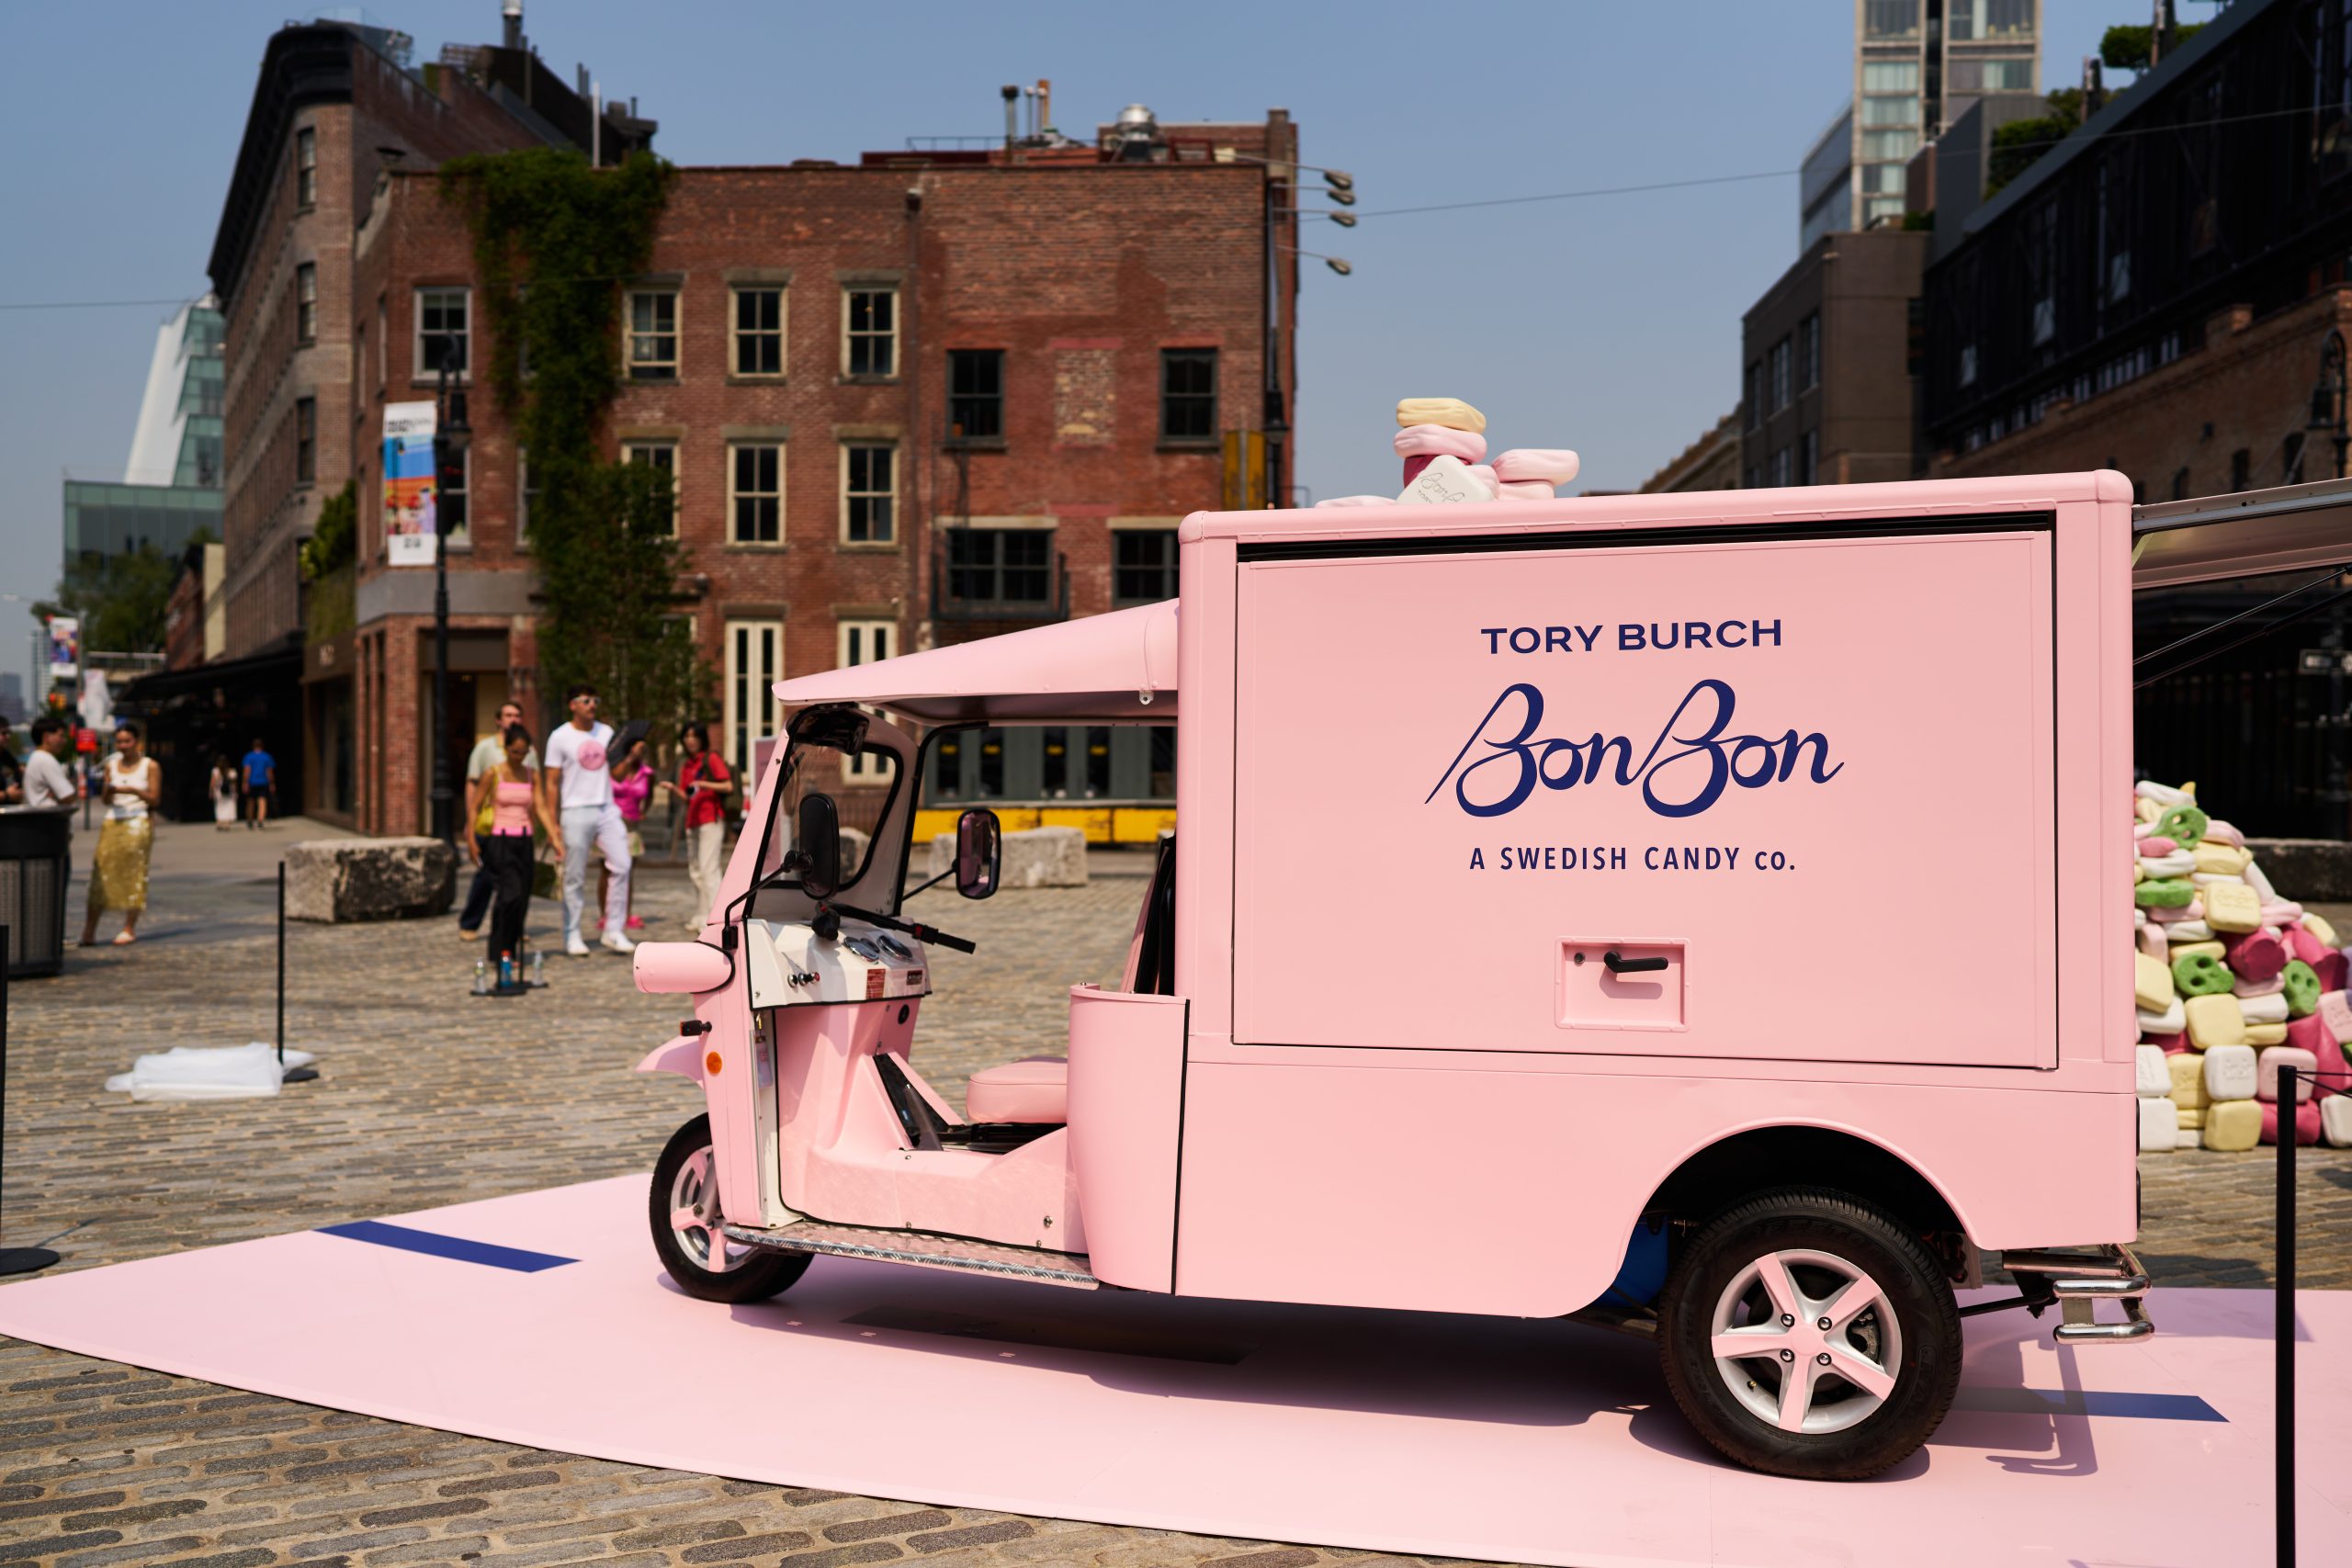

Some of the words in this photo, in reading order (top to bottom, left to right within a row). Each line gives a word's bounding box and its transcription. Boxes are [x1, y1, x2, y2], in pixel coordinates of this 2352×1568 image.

[1481, 625, 1603, 654] TORY
[1618, 619, 1781, 651] BURCH
[1424, 679, 1845, 818] BonBon
[1469, 847, 1486, 870] A
[1500, 846, 1626, 871] SWEDISH
[1644, 846, 1740, 871] CANDY
